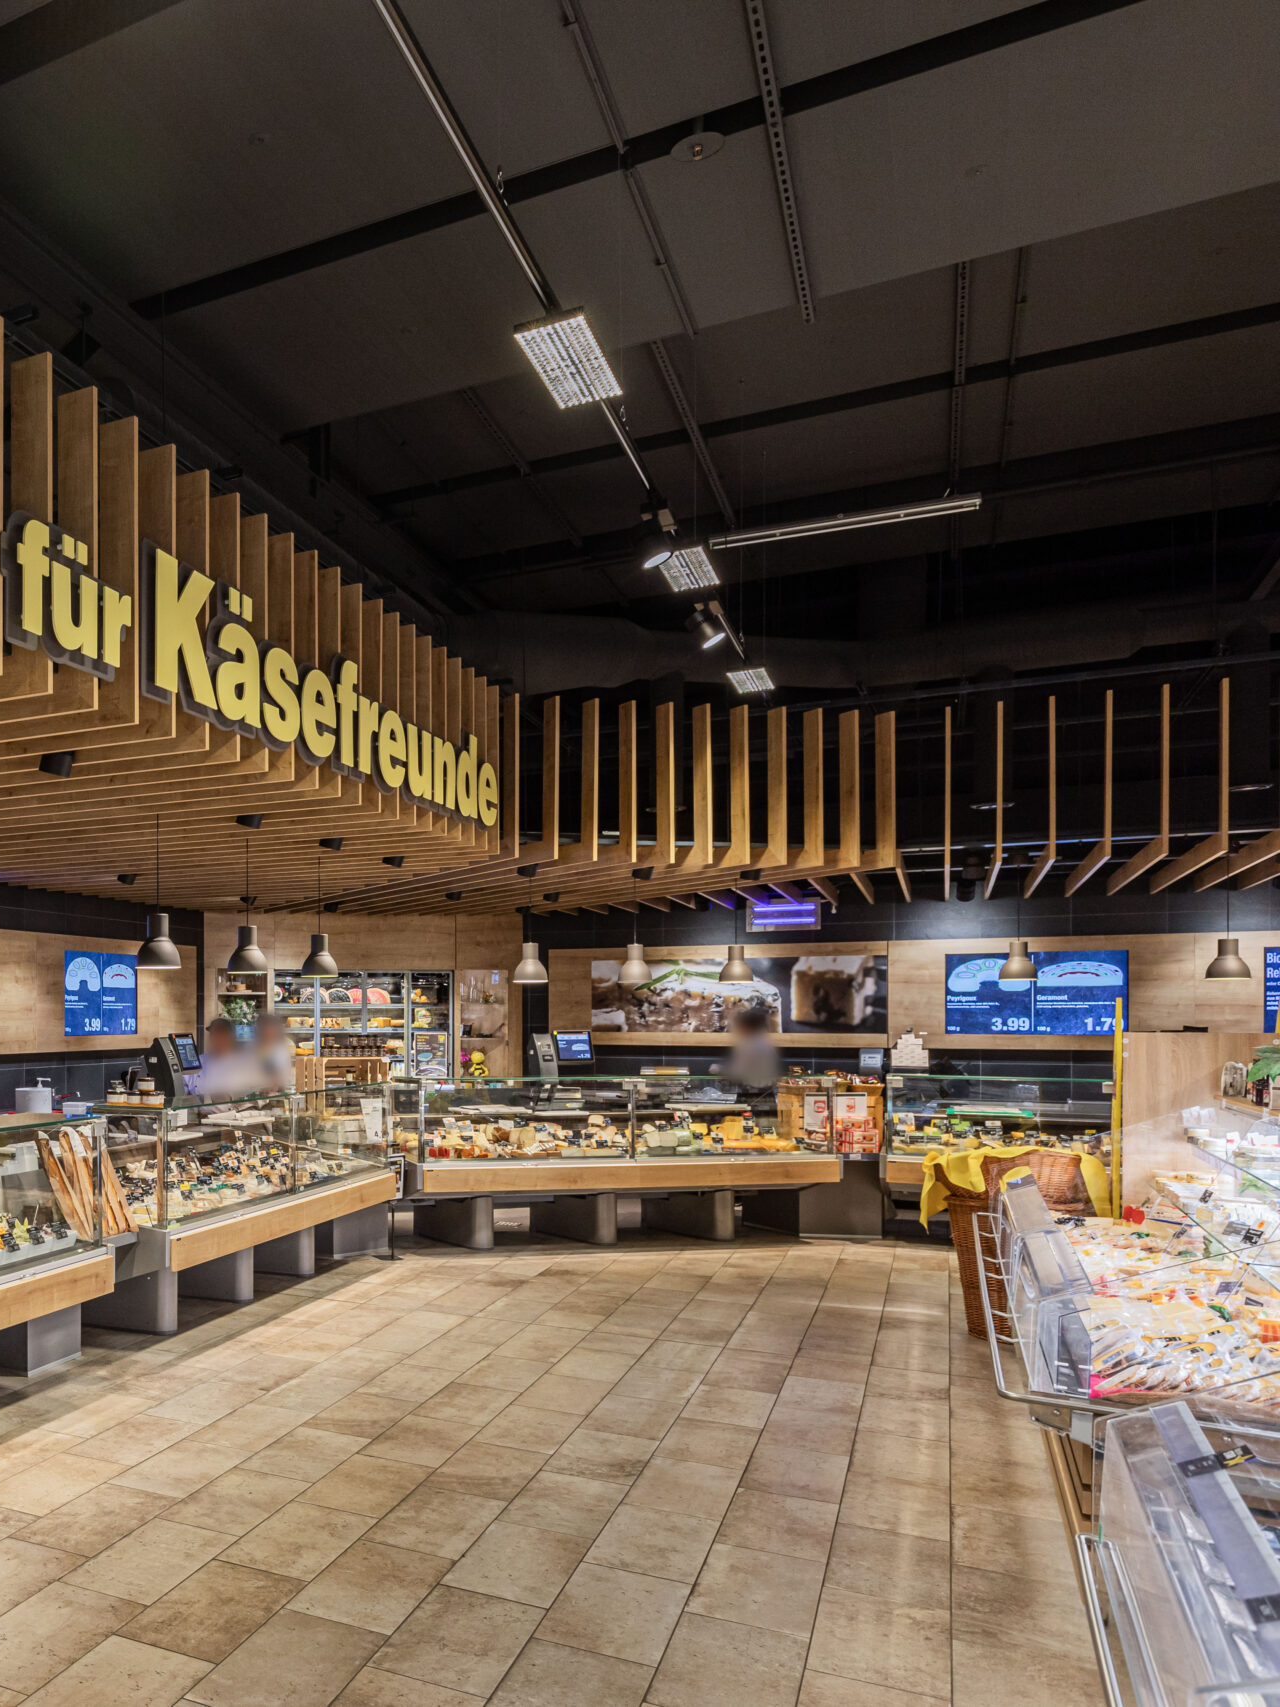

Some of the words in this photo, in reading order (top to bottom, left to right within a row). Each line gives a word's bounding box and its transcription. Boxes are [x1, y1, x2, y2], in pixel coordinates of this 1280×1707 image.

[17, 519, 131, 668] für
[155, 547, 499, 827] Käsefreunde
[84, 1018, 100, 1031] 3.99
[121, 1018, 136, 1031] 1.79
[991, 1017, 1030, 1031] 3.99
